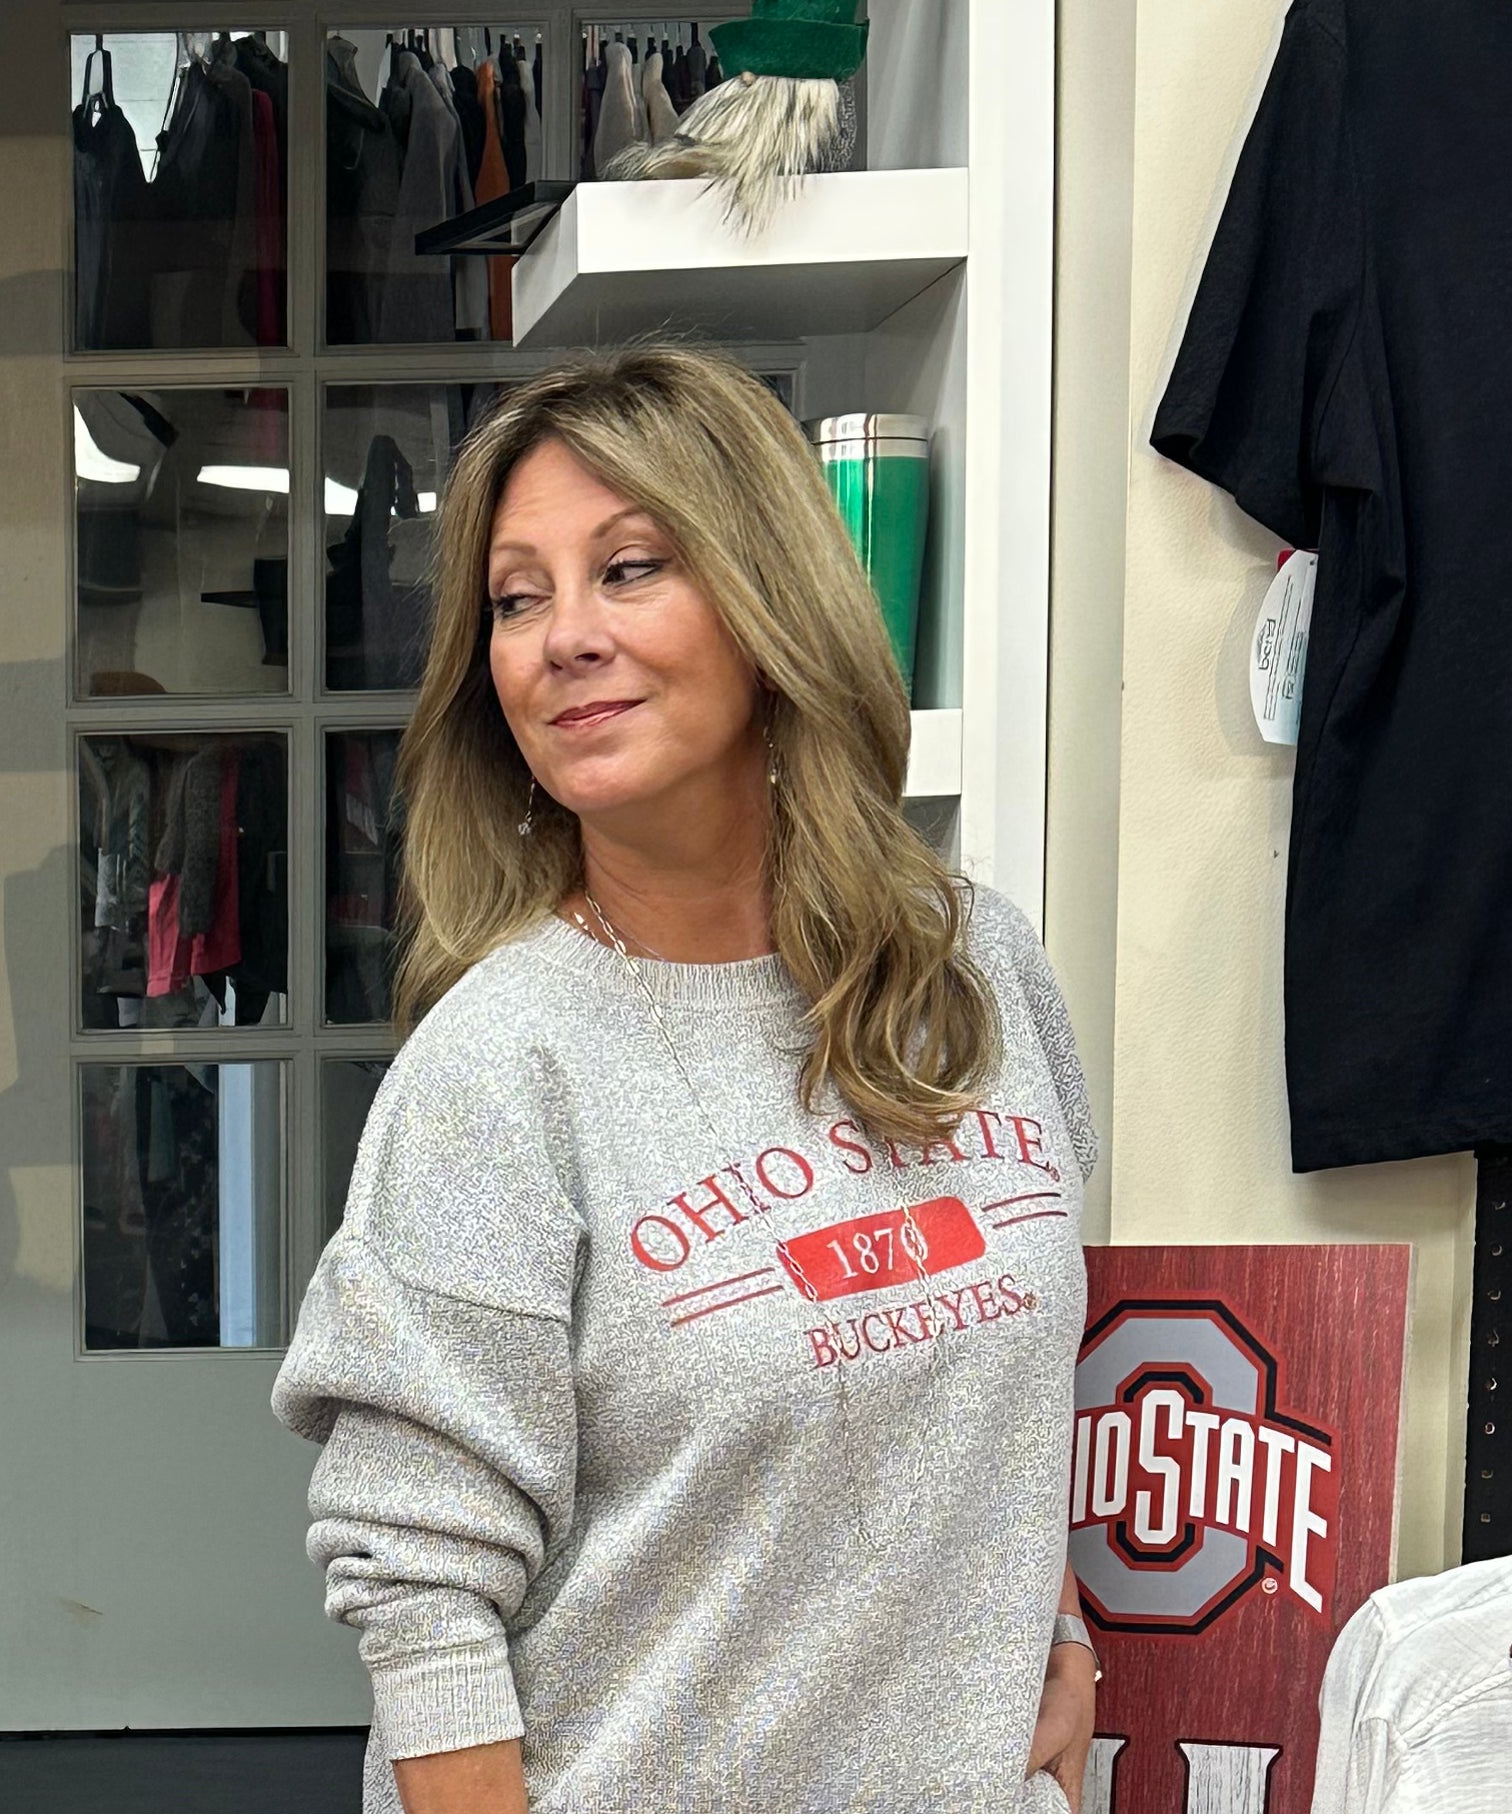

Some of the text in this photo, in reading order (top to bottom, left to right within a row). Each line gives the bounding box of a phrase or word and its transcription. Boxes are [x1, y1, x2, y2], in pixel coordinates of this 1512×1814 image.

[630, 1109, 1054, 1272] OHIO SATE
[826, 1228, 929, 1280] 1870
[807, 1274, 1025, 1370] BUCKEYES
